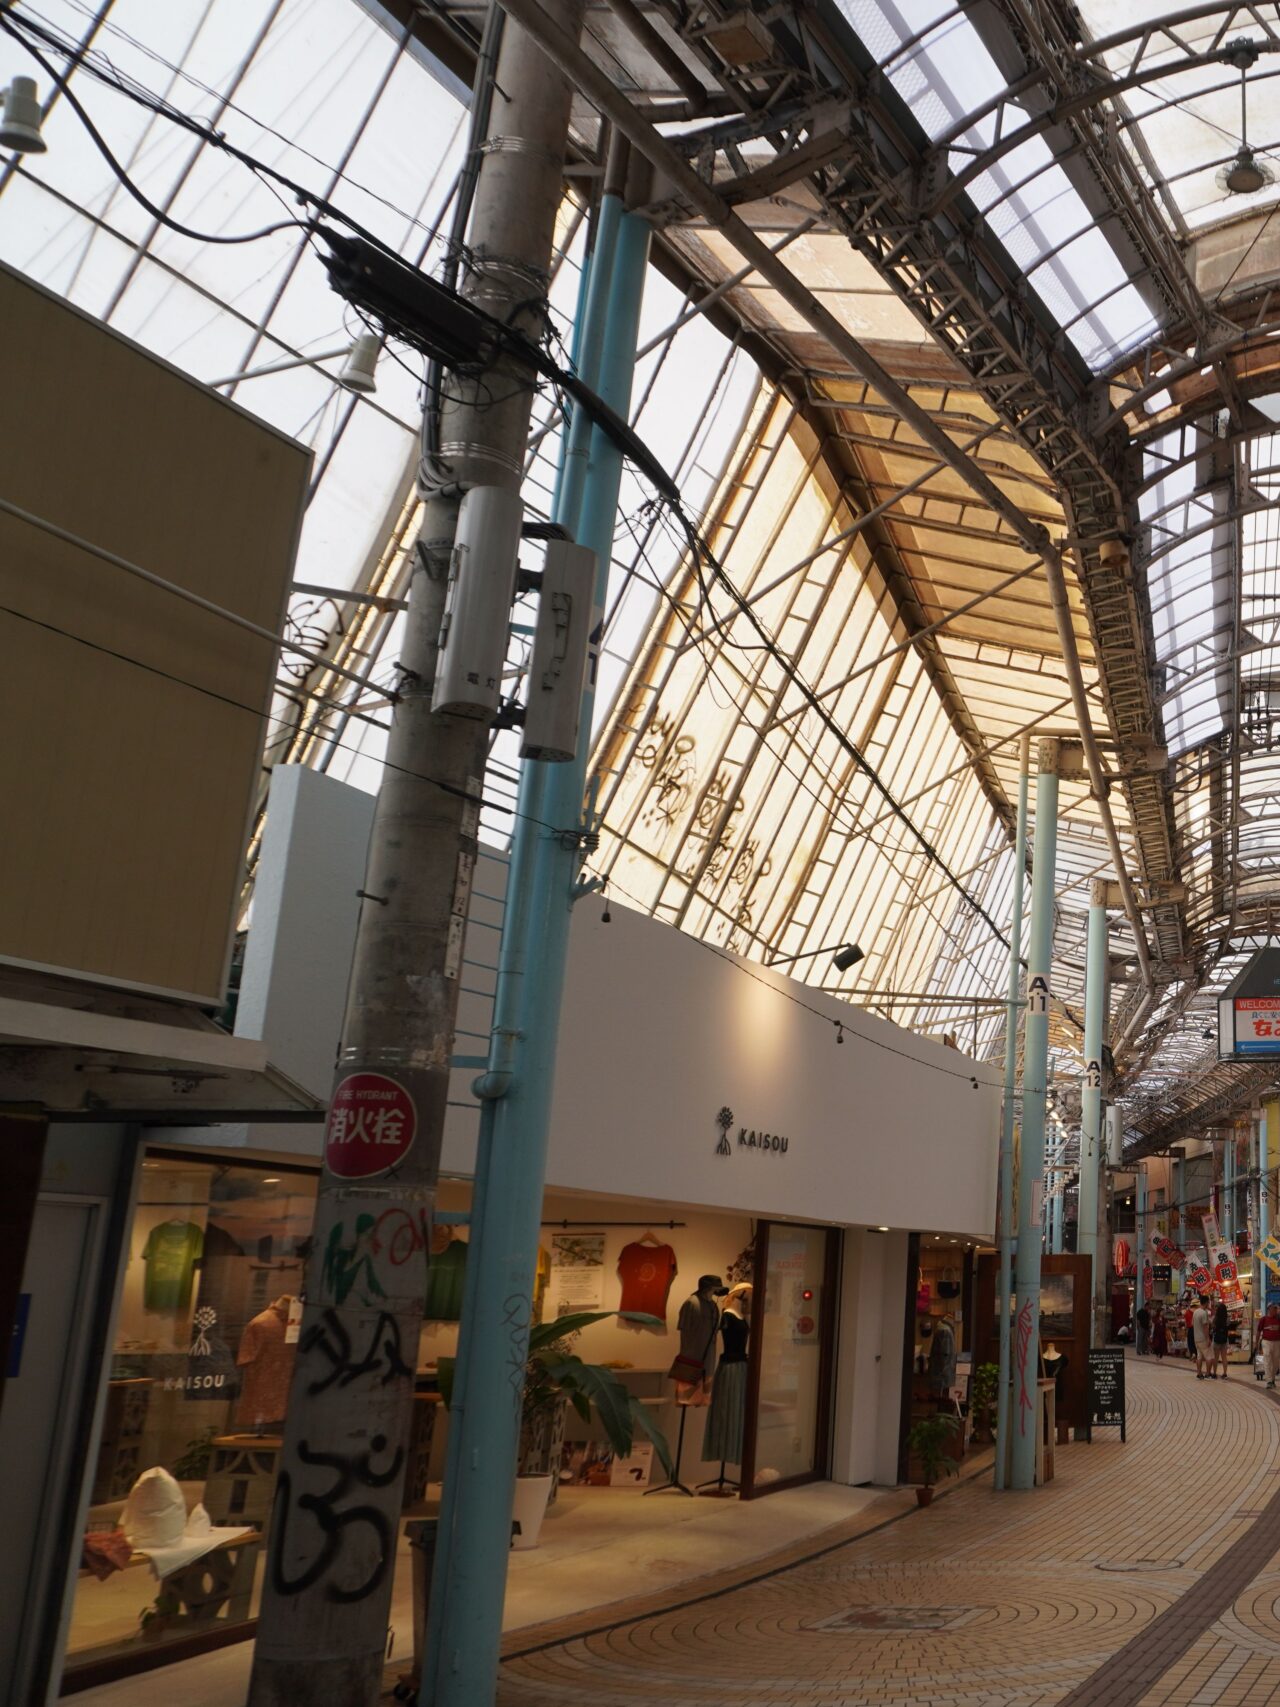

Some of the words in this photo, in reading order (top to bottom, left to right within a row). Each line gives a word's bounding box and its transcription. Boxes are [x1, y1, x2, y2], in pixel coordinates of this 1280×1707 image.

[1028, 976, 1049, 993] A
[1029, 996, 1046, 1011] 11
[1085, 1060, 1101, 1073] A
[1086, 1075, 1101, 1088] 12
[356, 1089, 399, 1100] HYDRANT
[328, 1107, 406, 1145] 消火栓
[740, 1127, 789, 1152] KAISOU
[1217, 1252, 1233, 1280] 免税
[163, 1374, 225, 1391] KAISOU
